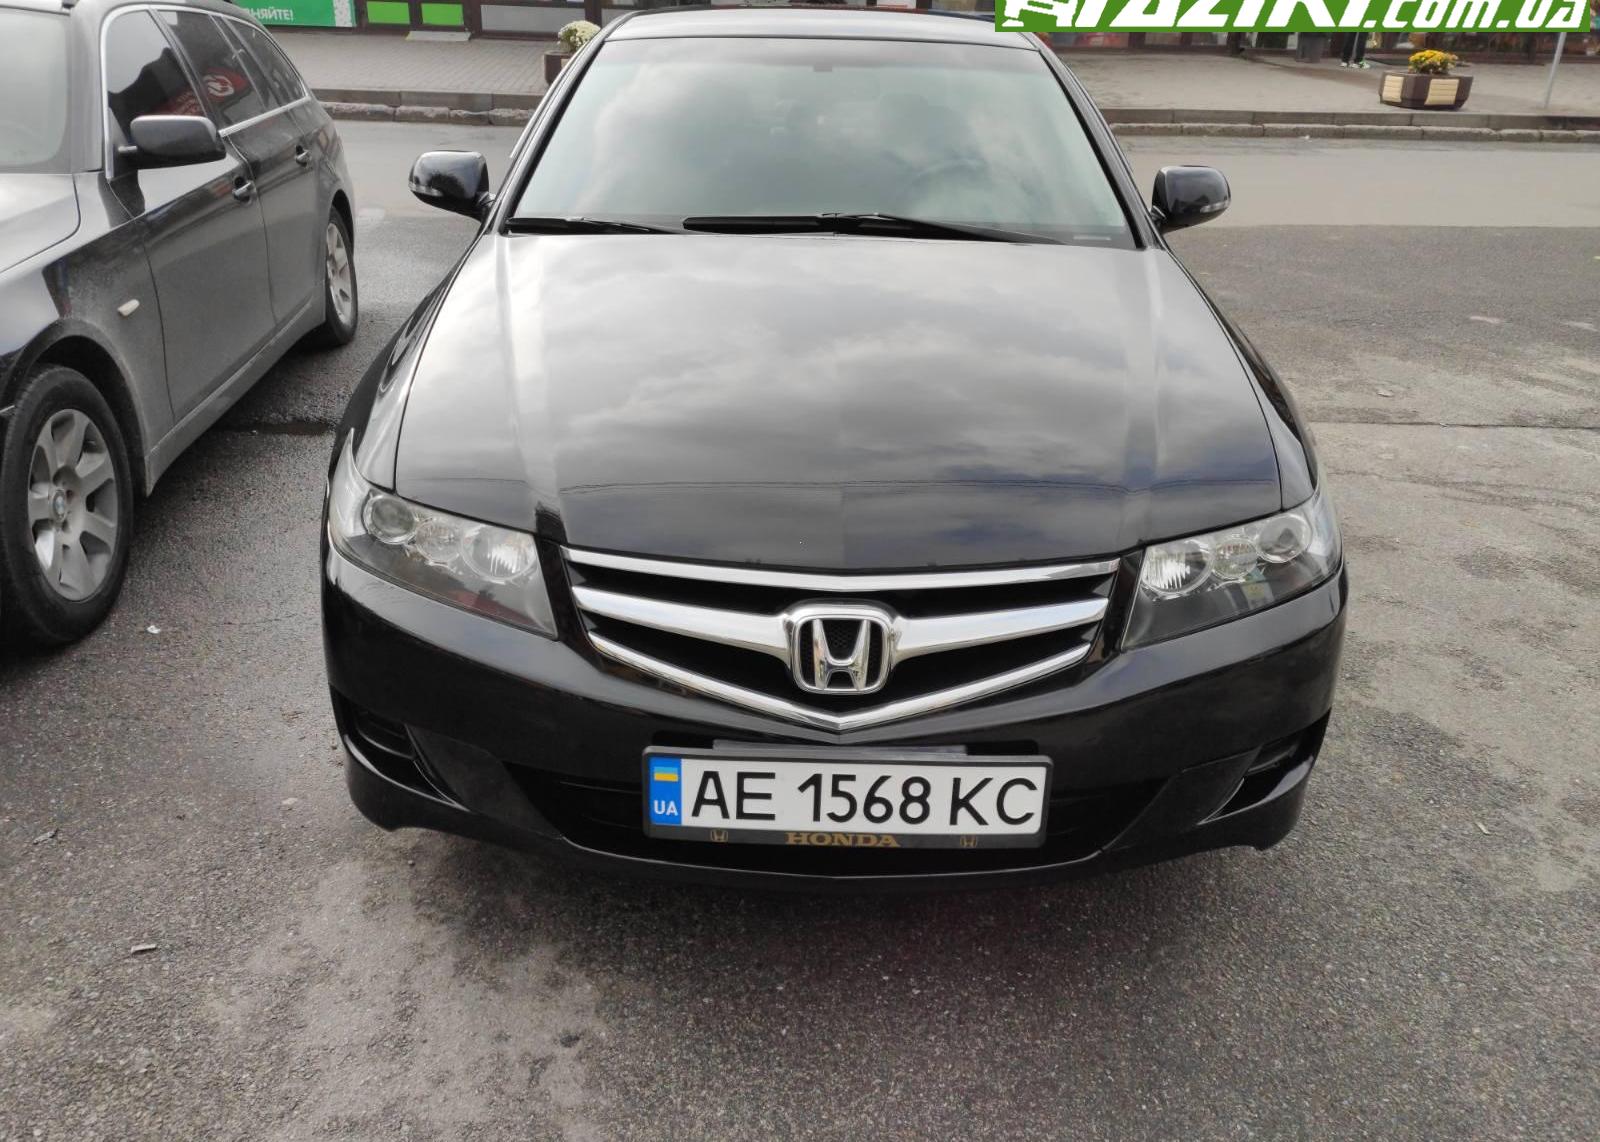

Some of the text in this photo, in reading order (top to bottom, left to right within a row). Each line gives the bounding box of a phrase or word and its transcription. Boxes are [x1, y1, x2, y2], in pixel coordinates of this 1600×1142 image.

[691, 770, 1039, 826] AE 1568 KC
[653, 800, 679, 816] UA
[785, 832, 901, 848] HONDA
